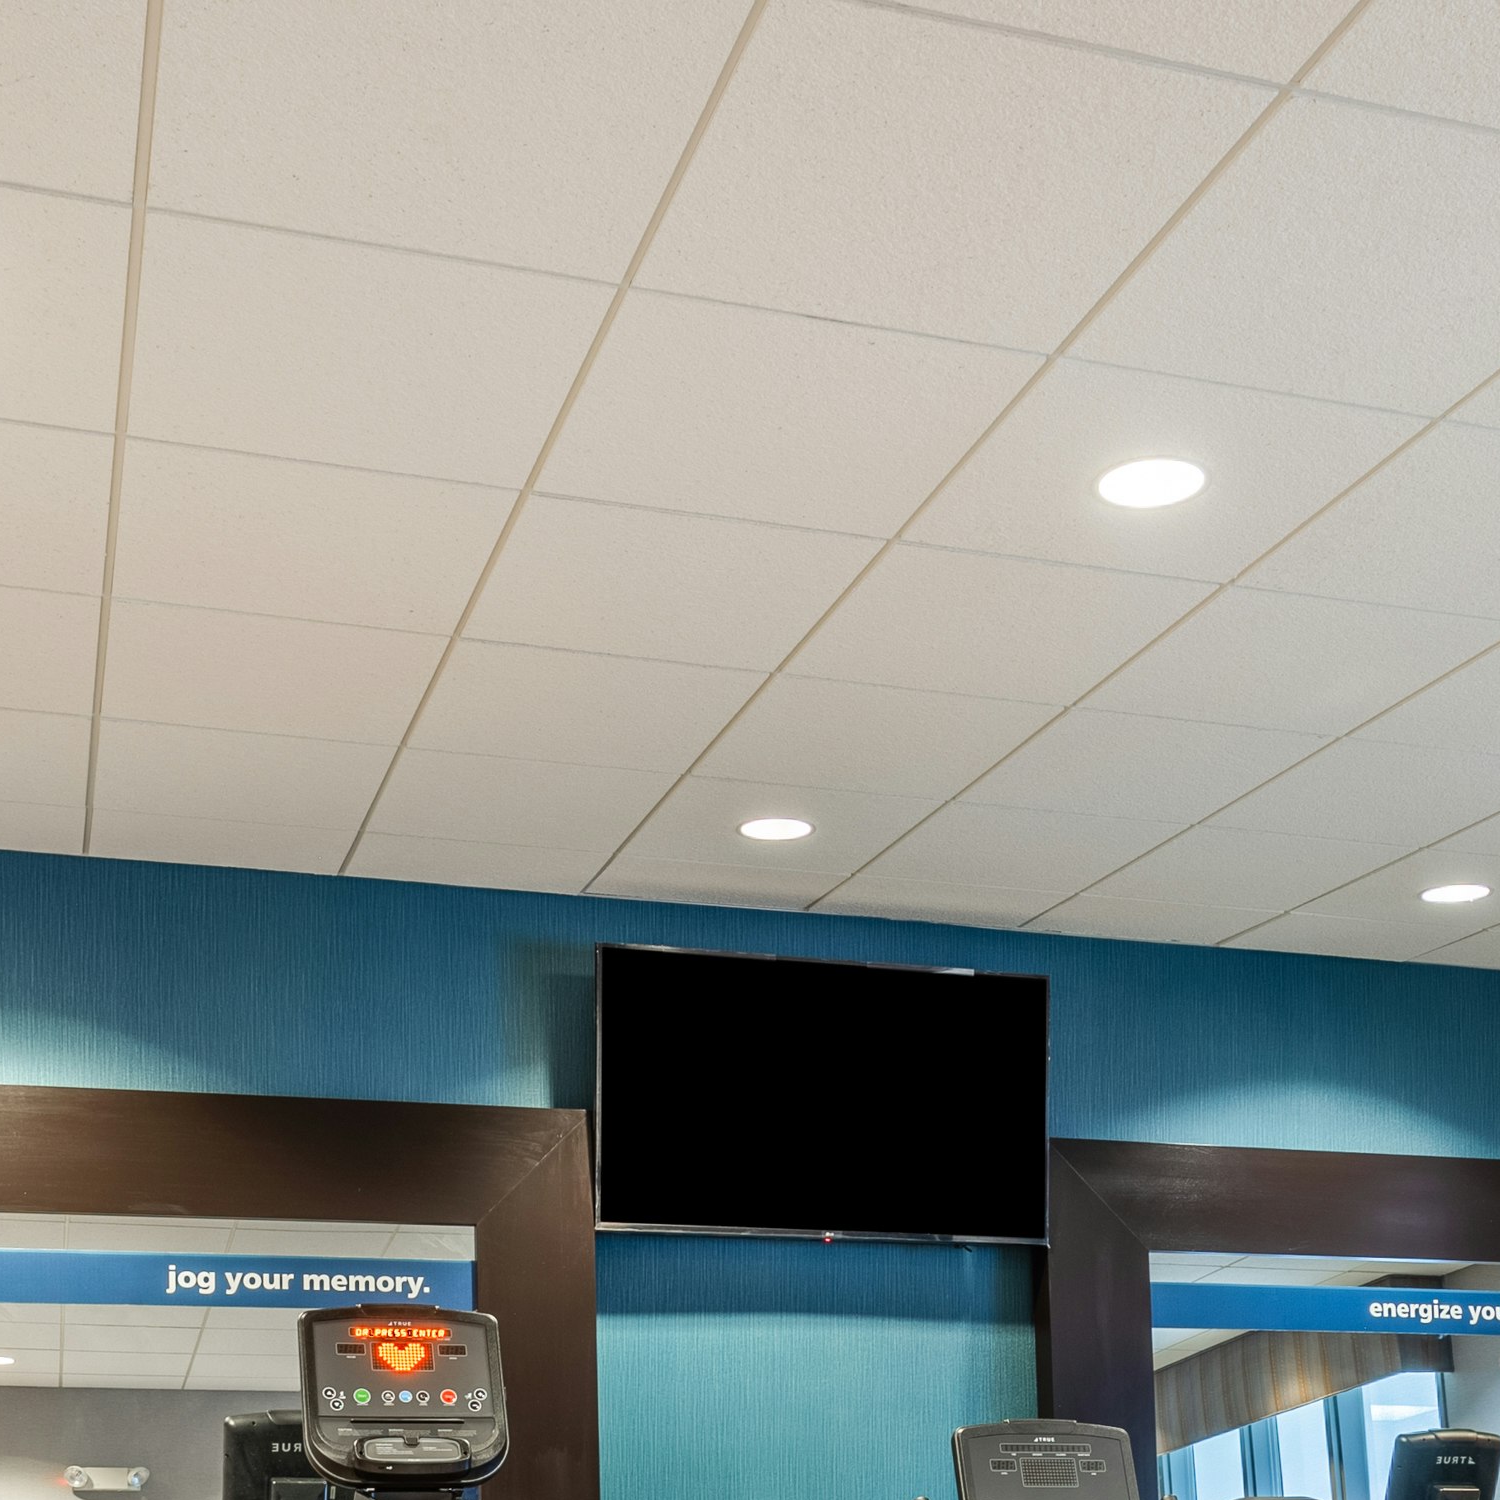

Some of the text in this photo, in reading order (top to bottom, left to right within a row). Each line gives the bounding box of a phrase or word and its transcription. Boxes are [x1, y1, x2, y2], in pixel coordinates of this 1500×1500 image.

[166, 1264, 430, 1298] jog your memory.
[1369, 1299, 1463, 1324] energize
[374, 1328, 407, 1338] PRESS
[414, 1328, 445, 1338] ENTER
